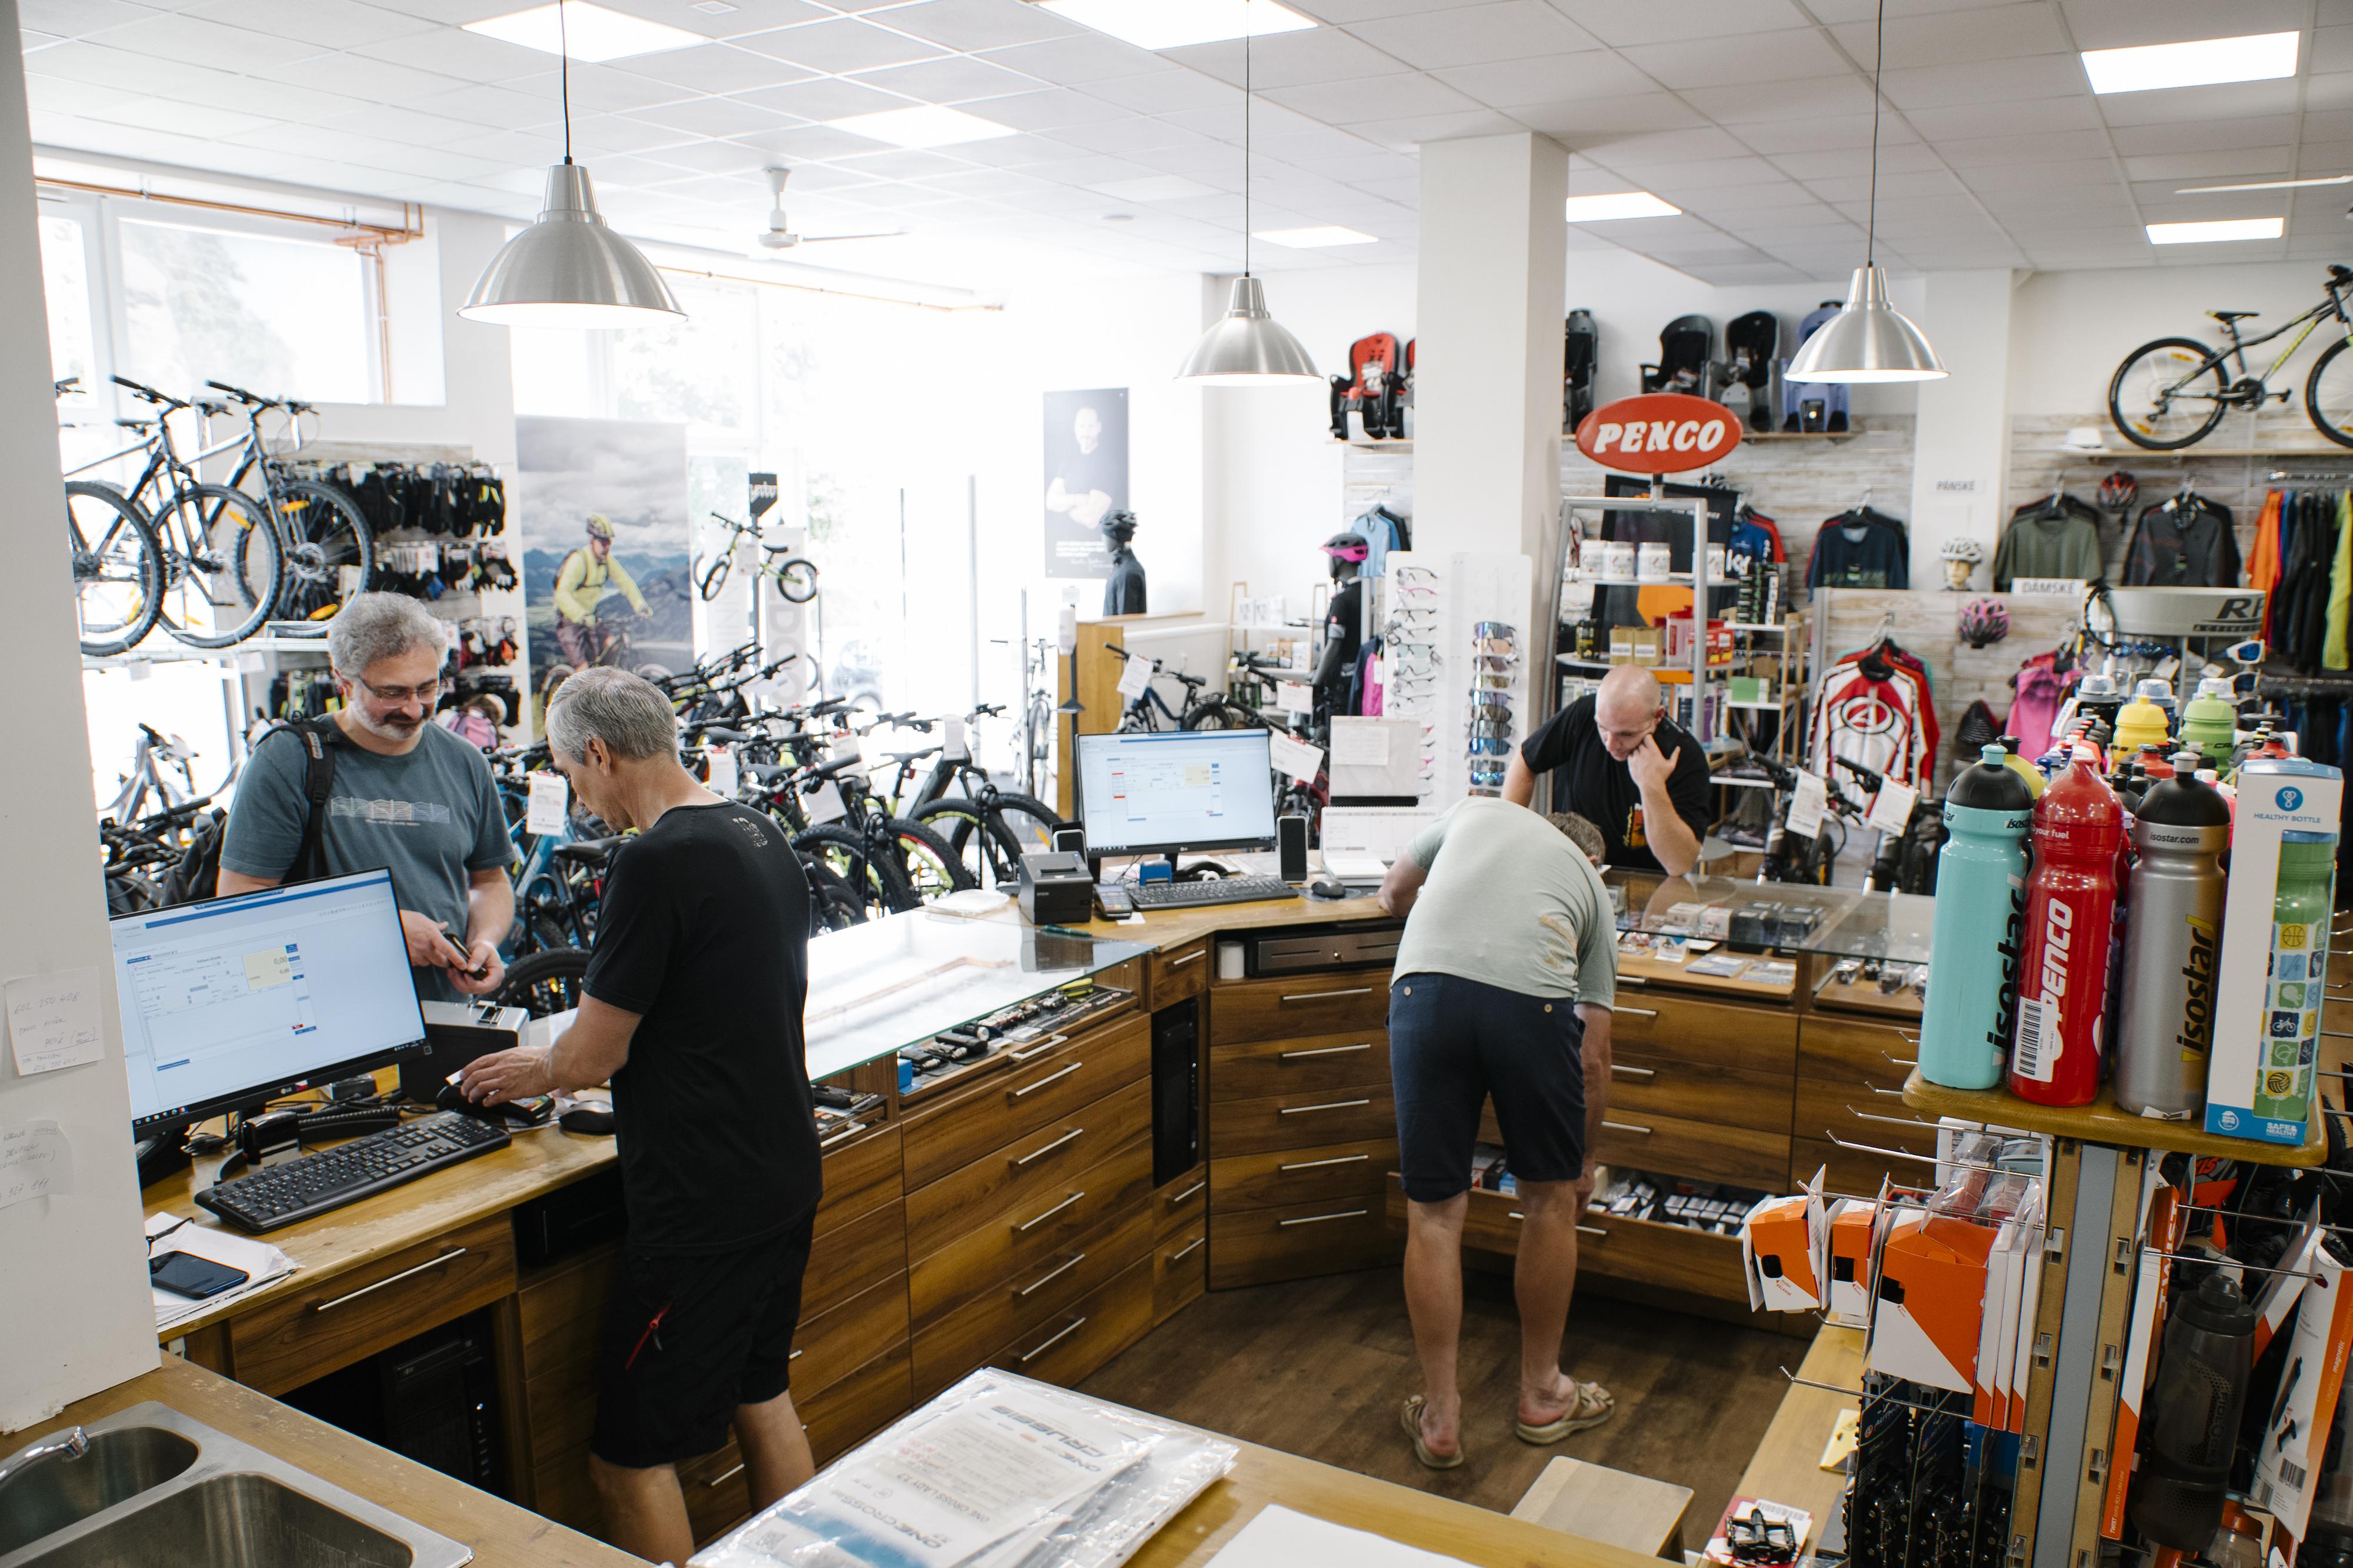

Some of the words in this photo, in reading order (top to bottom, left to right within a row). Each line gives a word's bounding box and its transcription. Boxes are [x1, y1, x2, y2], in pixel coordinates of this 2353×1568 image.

[1593, 419, 1725, 454] PENCO
[2254, 813, 2289, 821] HEALTHY
[2292, 815, 2321, 823] BOTTLE
[2051, 829, 2069, 839] fuel
[2149, 832, 2199, 844] isostar.com
[2177, 927, 2213, 1053] isostar
[2266, 1128, 2297, 1137] HEALTHY
[2159, 1200, 2178, 1320] TWIST
[2332, 1340, 2345, 1373] magnetic
[991, 1406, 1105, 1457] CRUSSIS
[909, 1477, 938, 1497] LADY
[841, 1495, 897, 1527] CROSS
[934, 1491, 969, 1514] CROSS
[968, 1509, 990, 1523] ONE
[2109, 1517, 2118, 1534] TWIST
[894, 1523, 942, 1549] ONE
